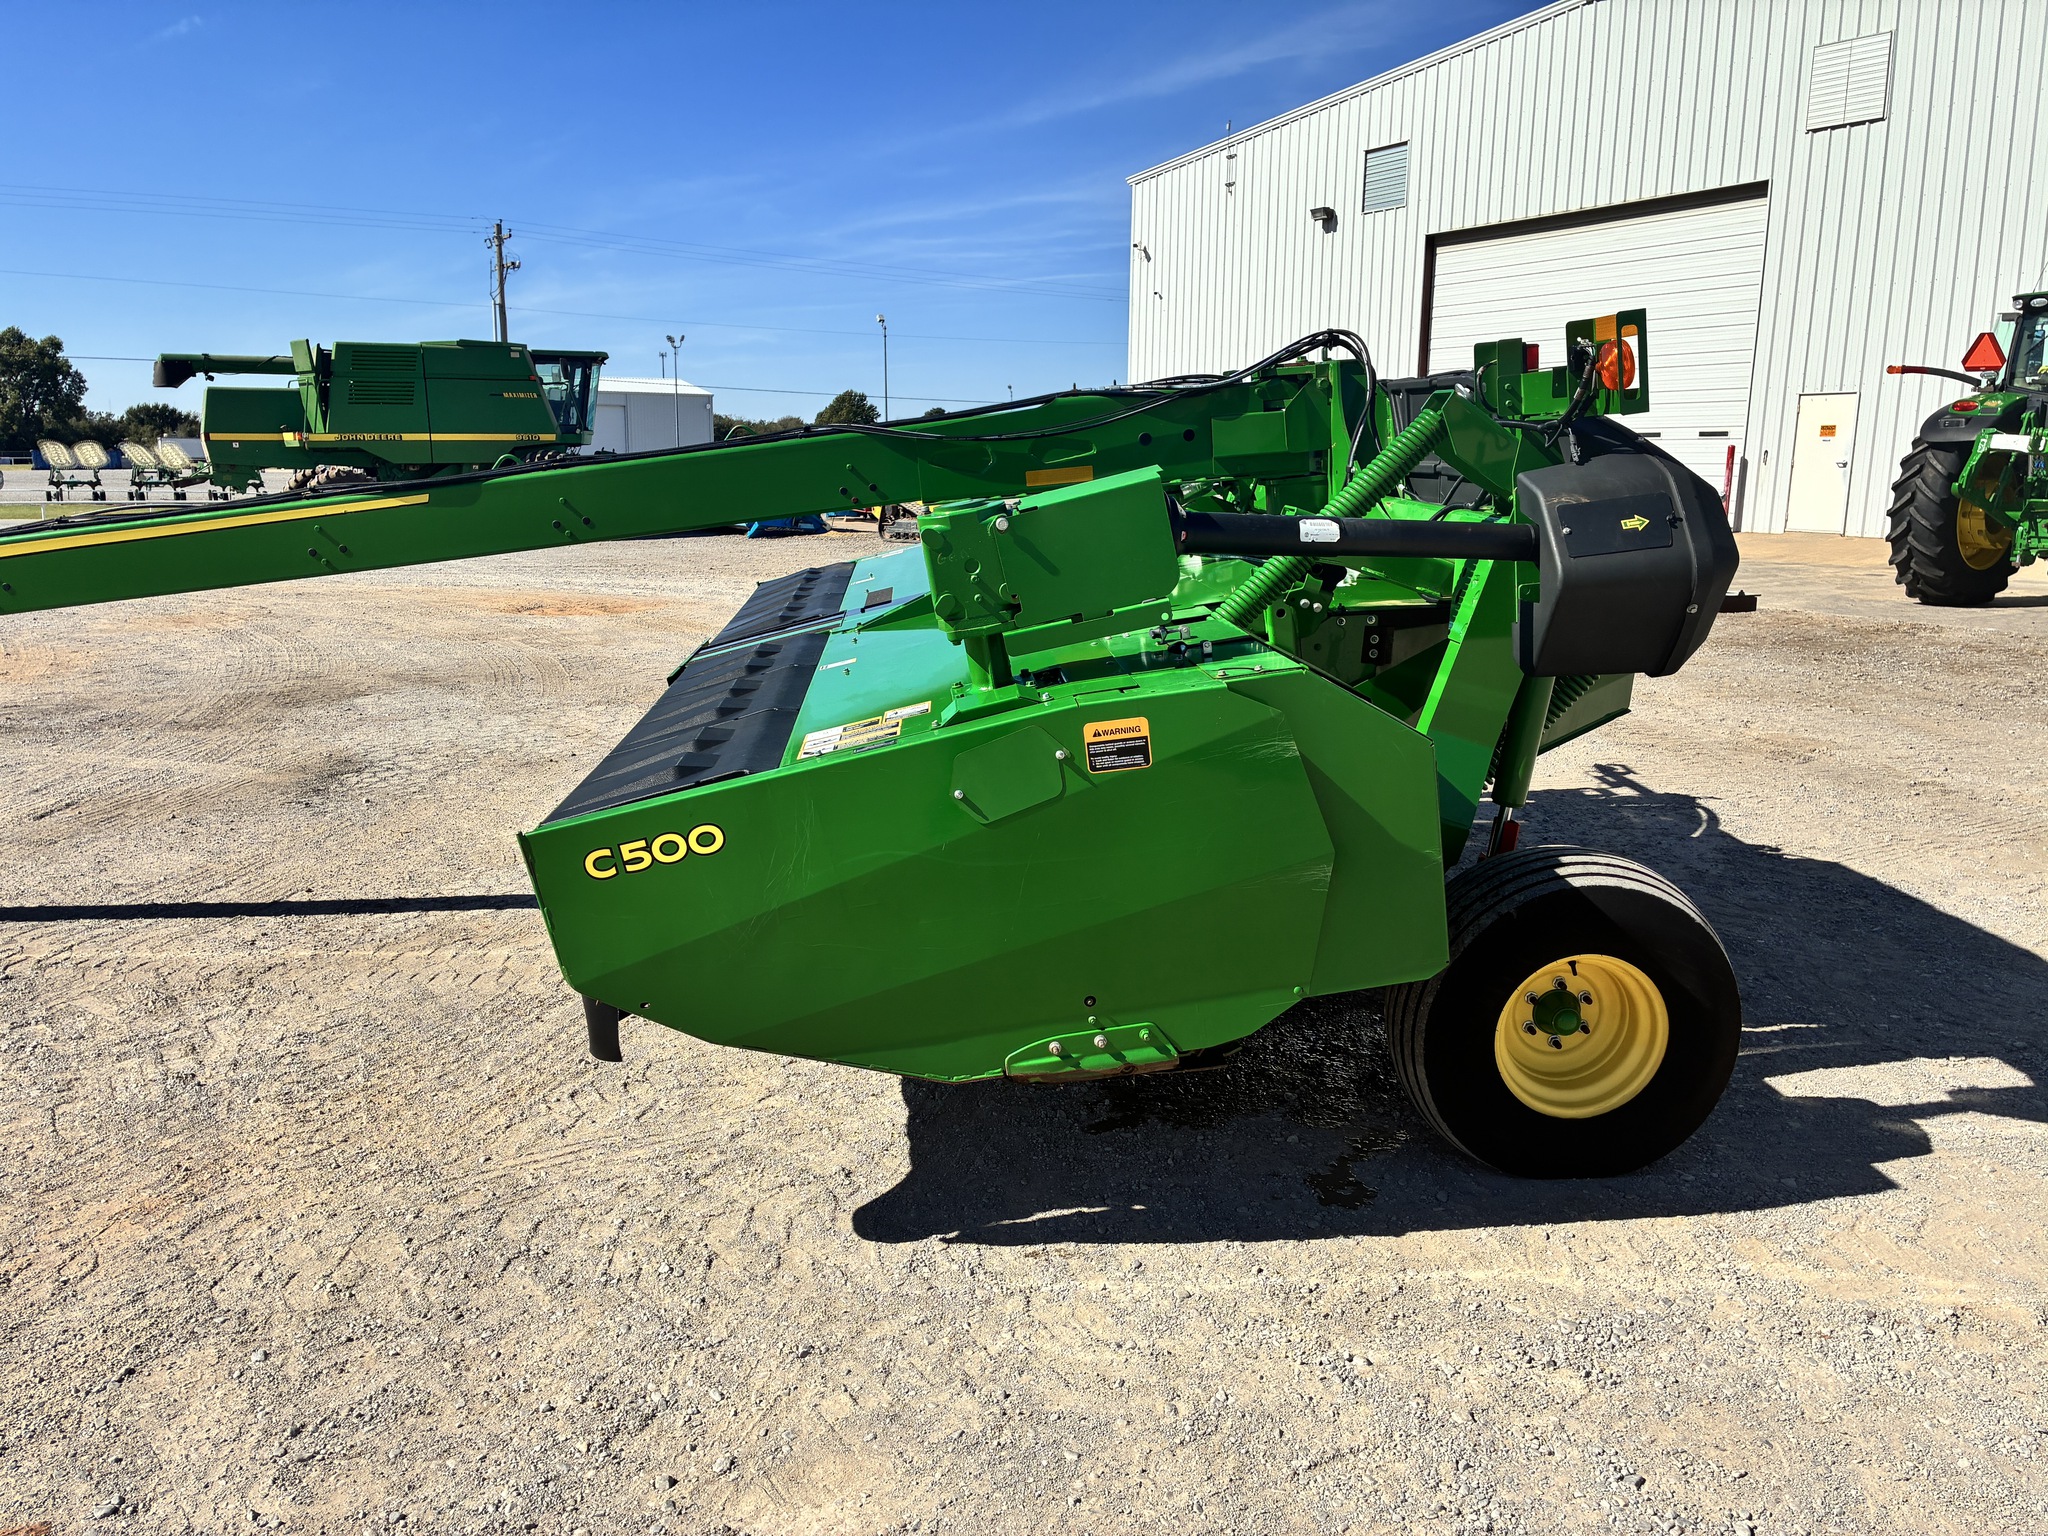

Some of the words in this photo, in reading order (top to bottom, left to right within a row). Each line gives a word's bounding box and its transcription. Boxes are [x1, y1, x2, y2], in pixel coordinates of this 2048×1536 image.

[334, 433, 364, 441] JOHN
[366, 433, 402, 441] DEERE
[1101, 725, 1141, 737] WARNING
